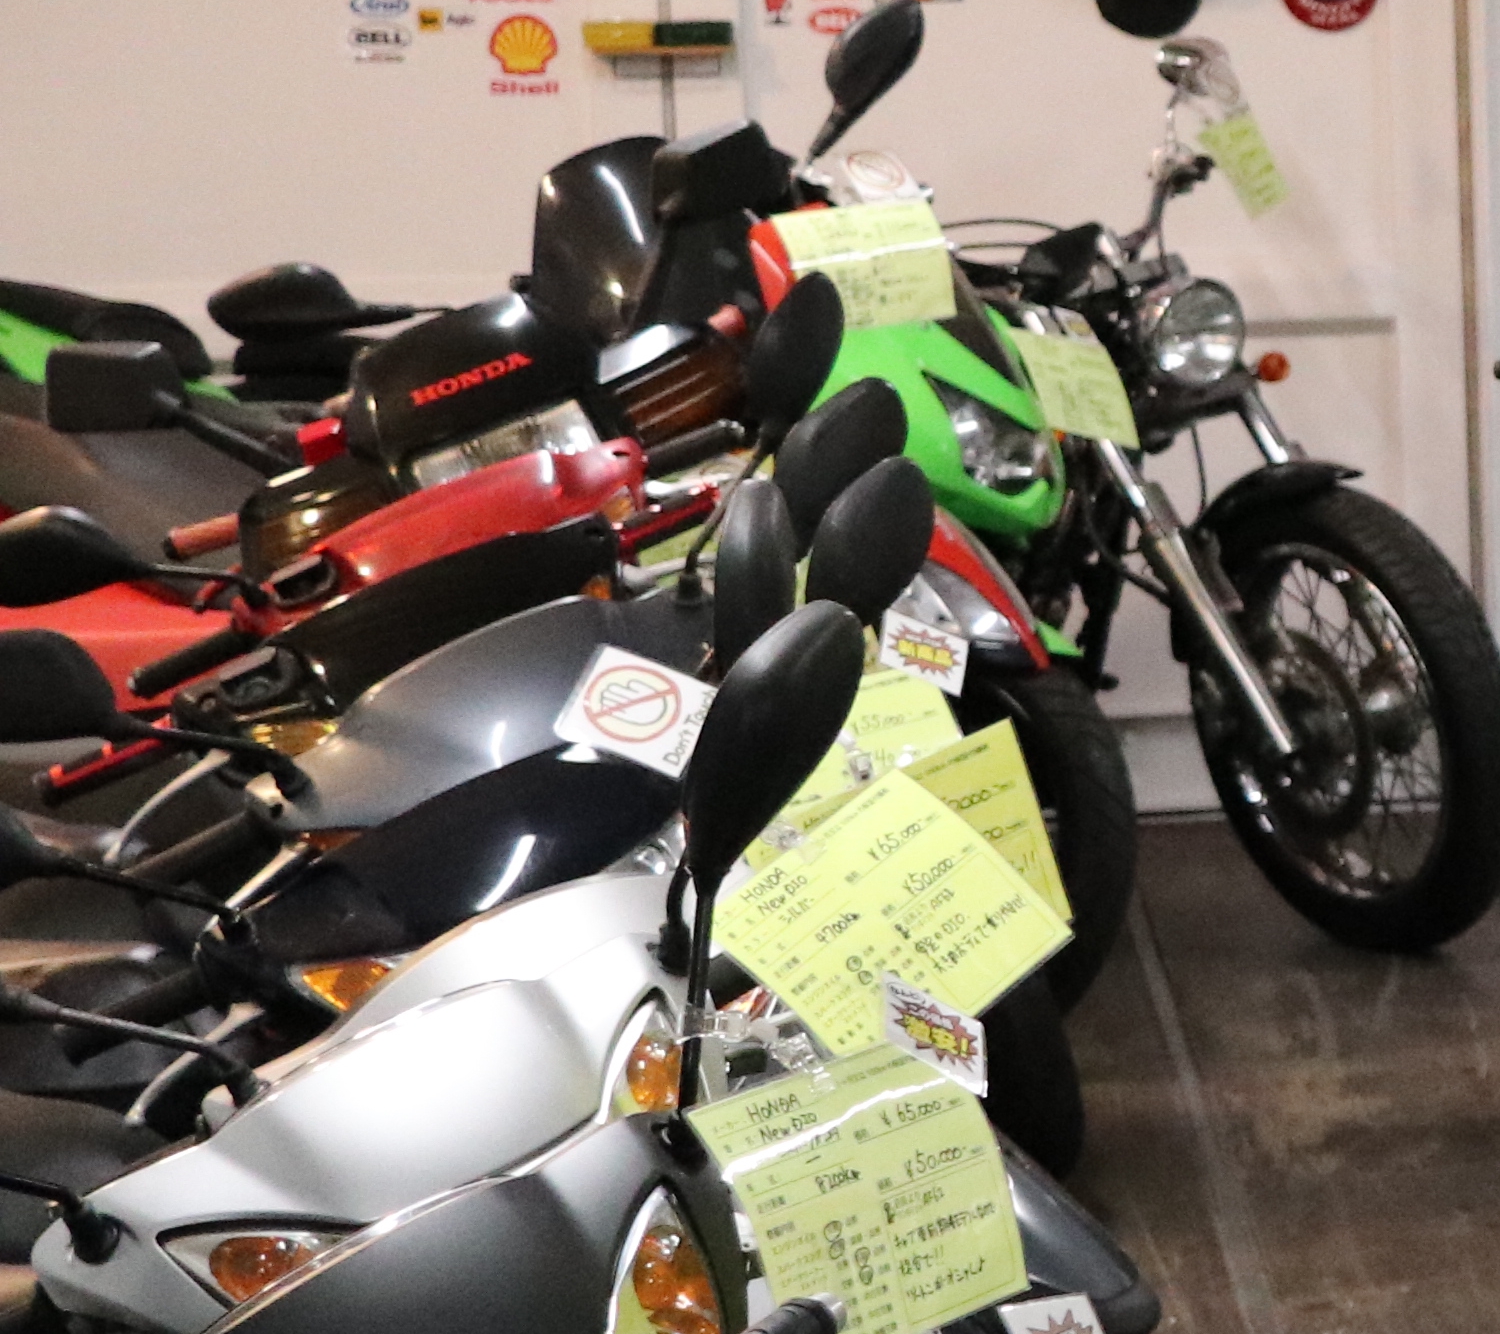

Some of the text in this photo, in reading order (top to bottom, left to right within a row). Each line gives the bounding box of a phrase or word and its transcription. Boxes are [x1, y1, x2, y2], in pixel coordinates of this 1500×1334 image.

[489, 80, 560, 95] Shell
[409, 351, 533, 407] HONDA
[662, 721, 696, 767] Don't
[757, 1126, 791, 1145] New
